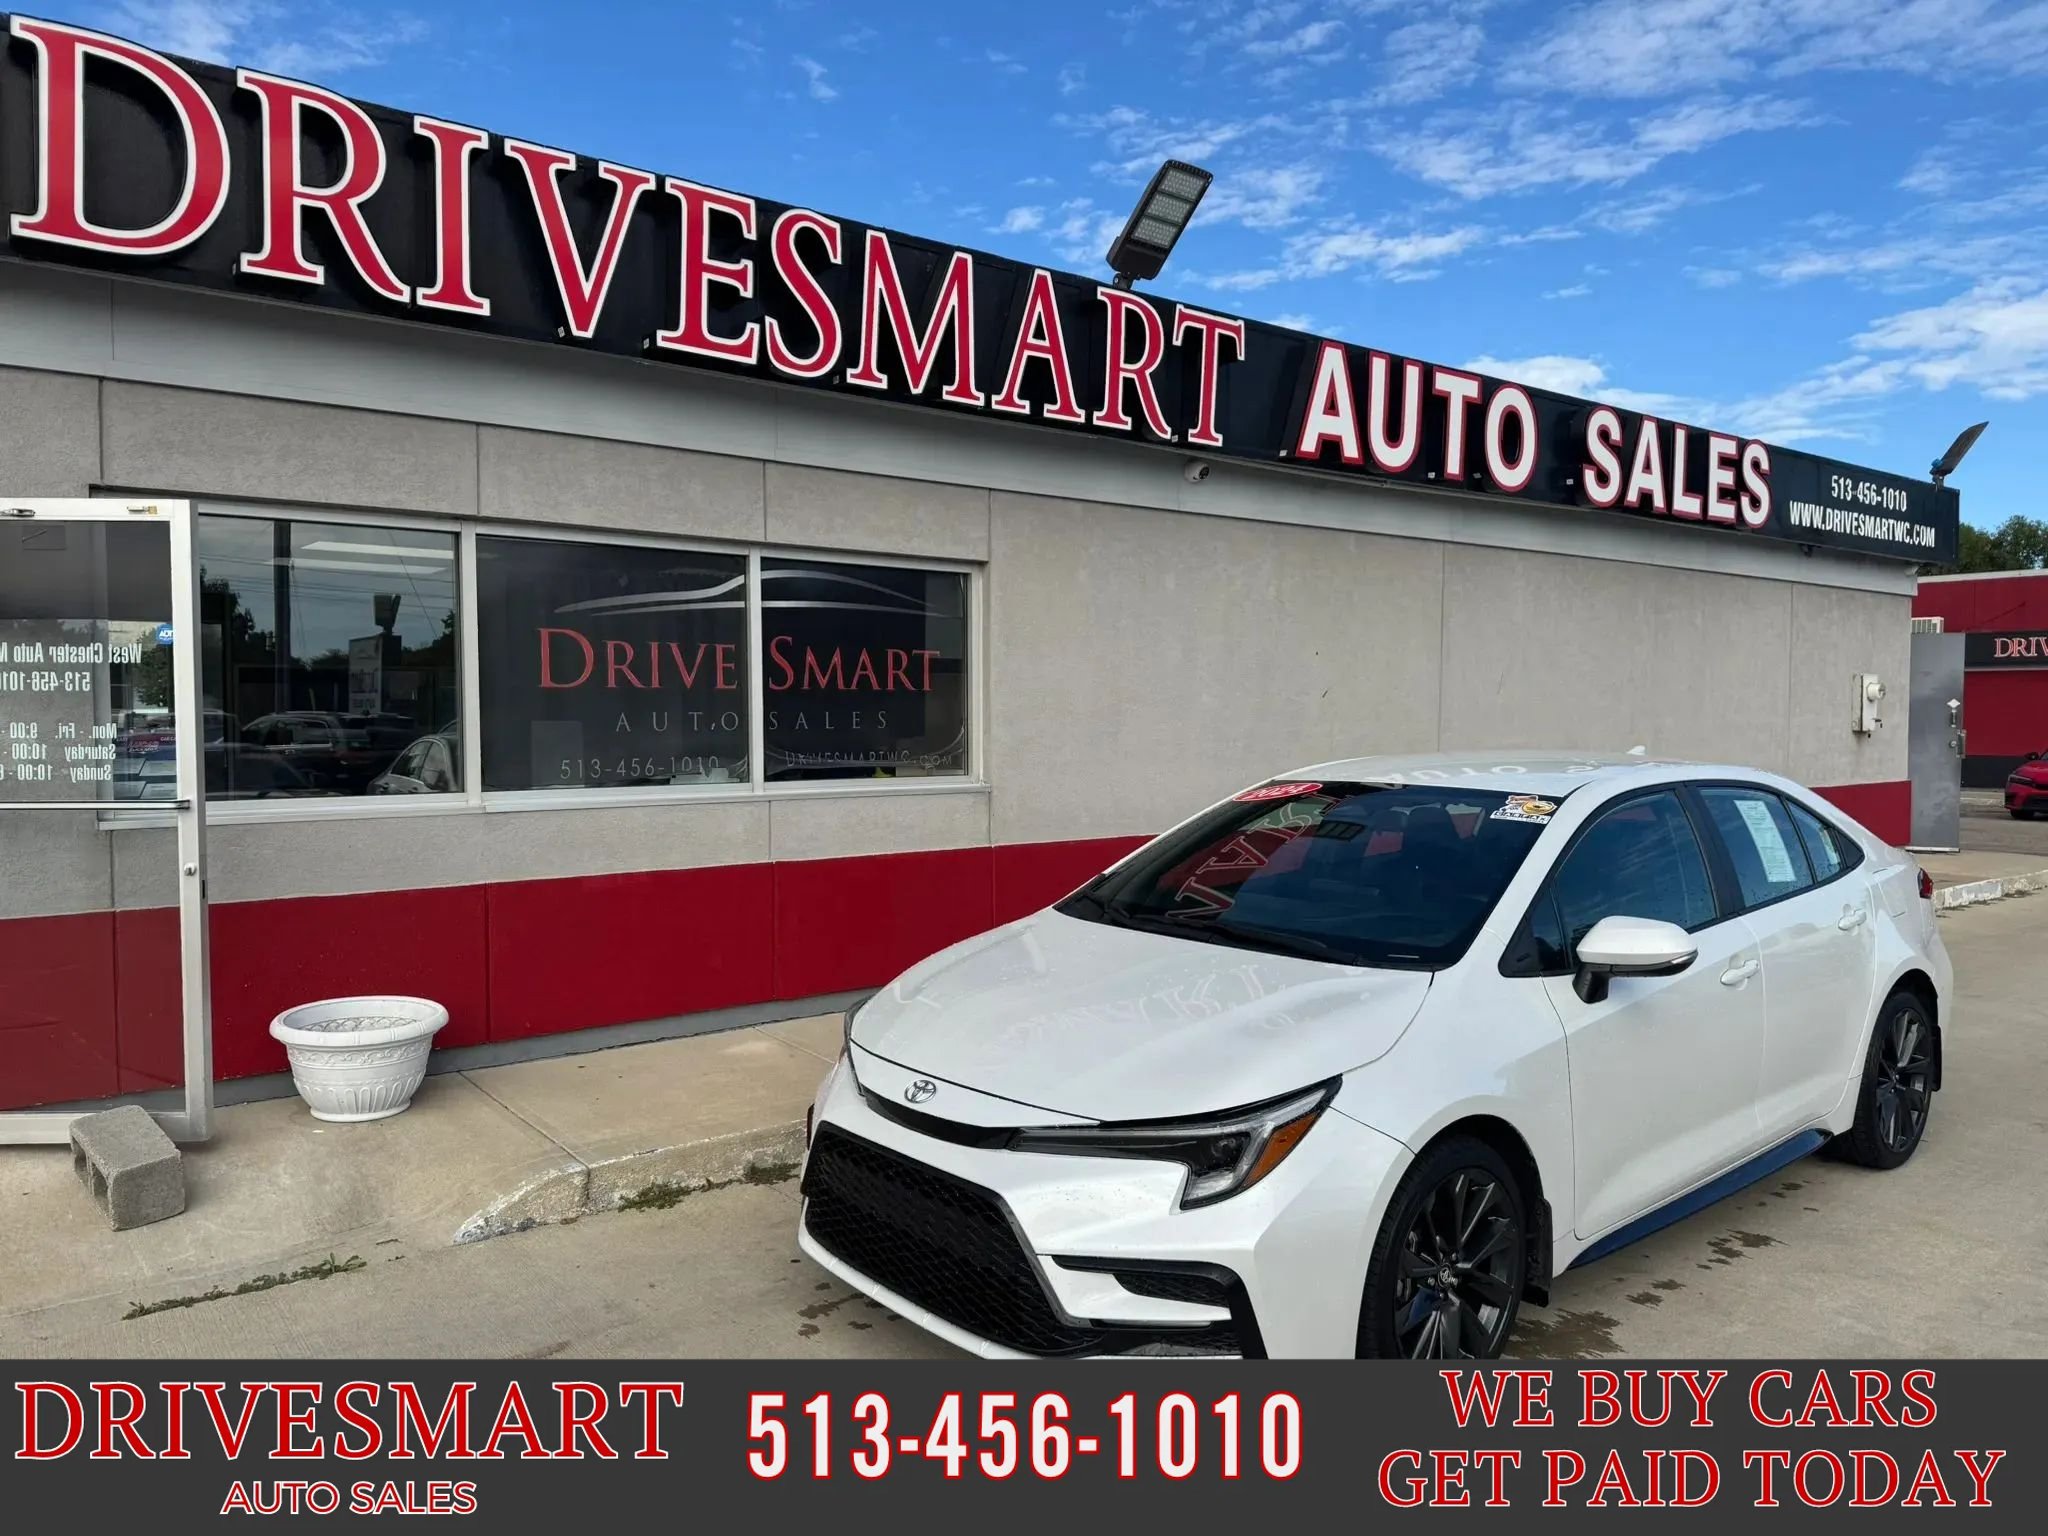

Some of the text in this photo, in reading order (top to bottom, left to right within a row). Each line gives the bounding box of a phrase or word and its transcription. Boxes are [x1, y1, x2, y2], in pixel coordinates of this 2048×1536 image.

[10, 13, 1772, 529] DRIVESMART AUTO SALES
[1831, 475, 1907, 512] 513-456-1010
[1789, 500, 1936, 548] WWW.DRIVESMARTWC.COM
[537, 628, 941, 692] DRIVE SMART
[615, 711, 888, 733] AUTO SALES
